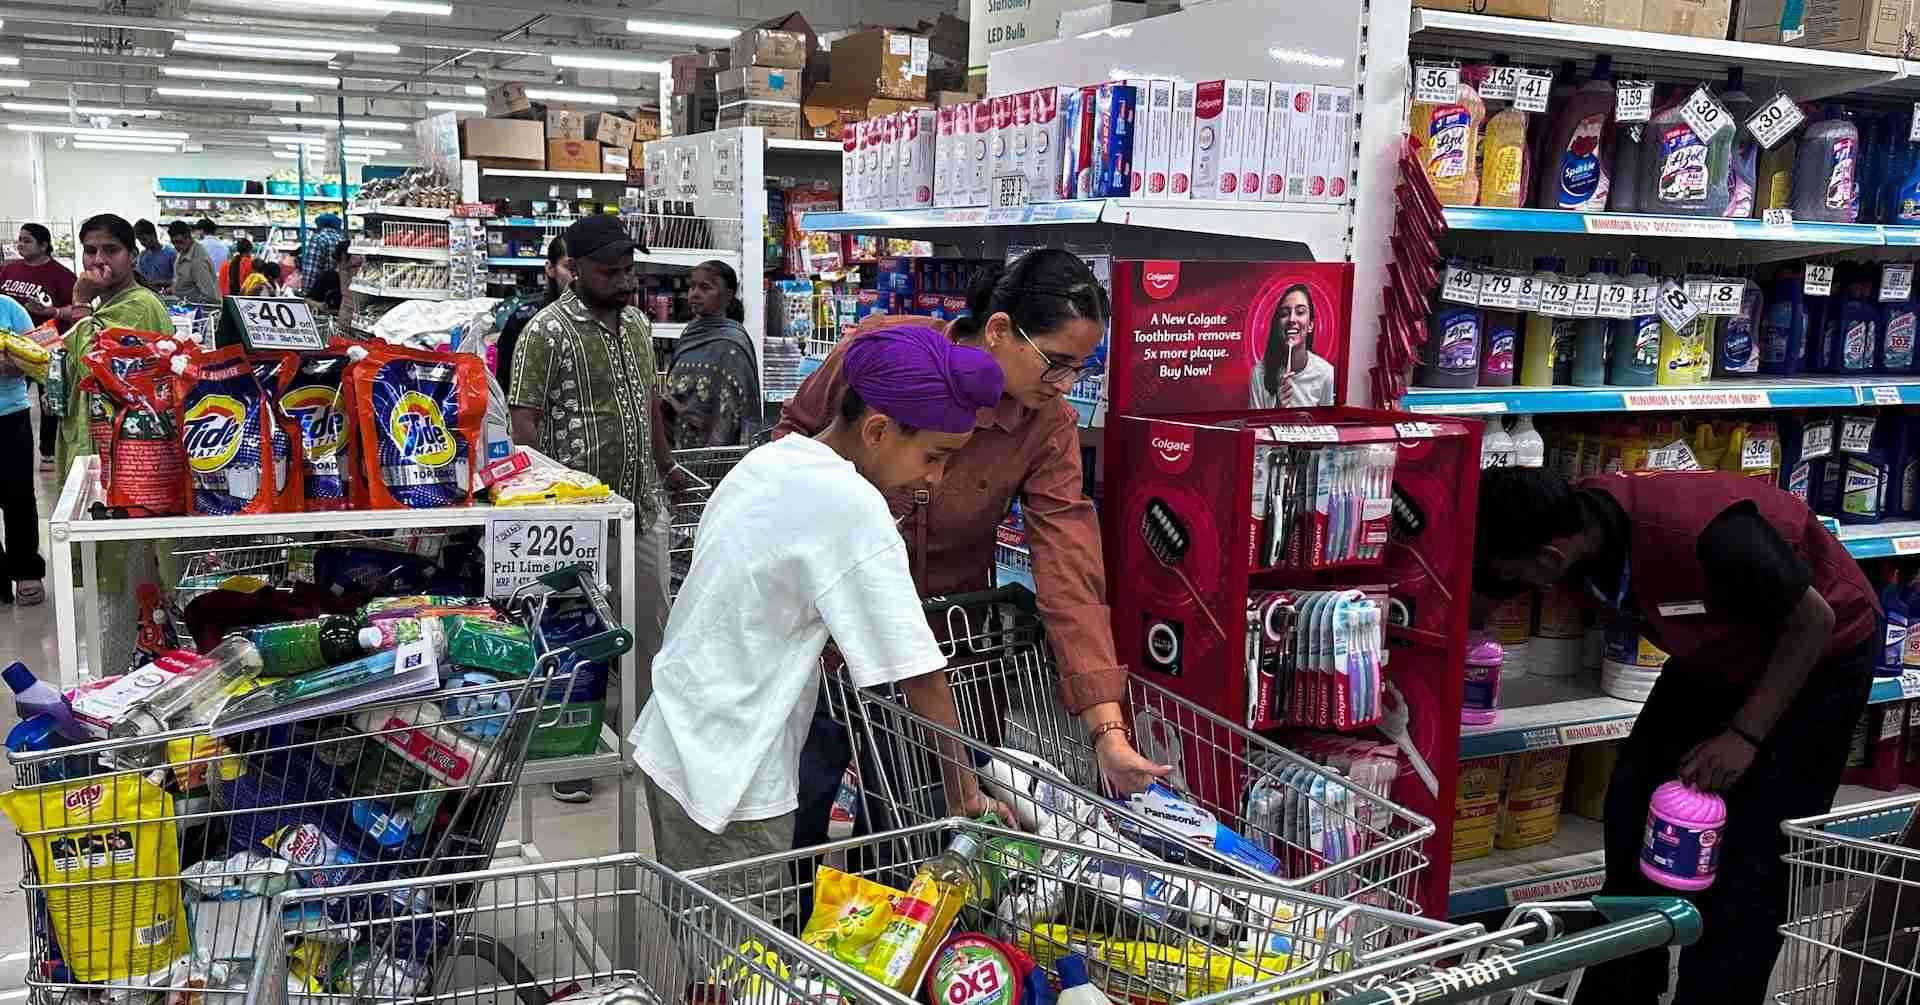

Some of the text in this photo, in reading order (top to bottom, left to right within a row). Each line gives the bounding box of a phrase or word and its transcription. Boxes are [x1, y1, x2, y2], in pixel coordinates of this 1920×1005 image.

[988, 23, 1025, 43] LED Bulb
[1146, 271, 1175, 282] Colgate
[260, 302, 295, 328] 40
[1150, 313, 1227, 328] A New Colgate
[1134, 330, 1241, 342] Toothbrush removes
[1144, 346, 1230, 361] 5x more plaque.
[1160, 363, 1212, 380] Buy Now!
[183, 413, 239, 450] Tide
[400, 412, 447, 456] Tide
[416, 443, 448, 456] MATIC
[1152, 437, 1191, 452] Colgate
[509, 542, 521, 558] ₹
[527, 525, 574, 556] 226
[576, 546, 598, 558] Off
[1312, 522, 1322, 566] Colgate
[494, 561, 515, 573] Pril
[520, 561, 551, 573] Lime
[1336, 683, 1345, 727] Colgate
[1144, 806, 1201, 827] Panasonic
[948, 961, 1000, 1005] EXO
[1432, 955, 1518, 995] Mart
